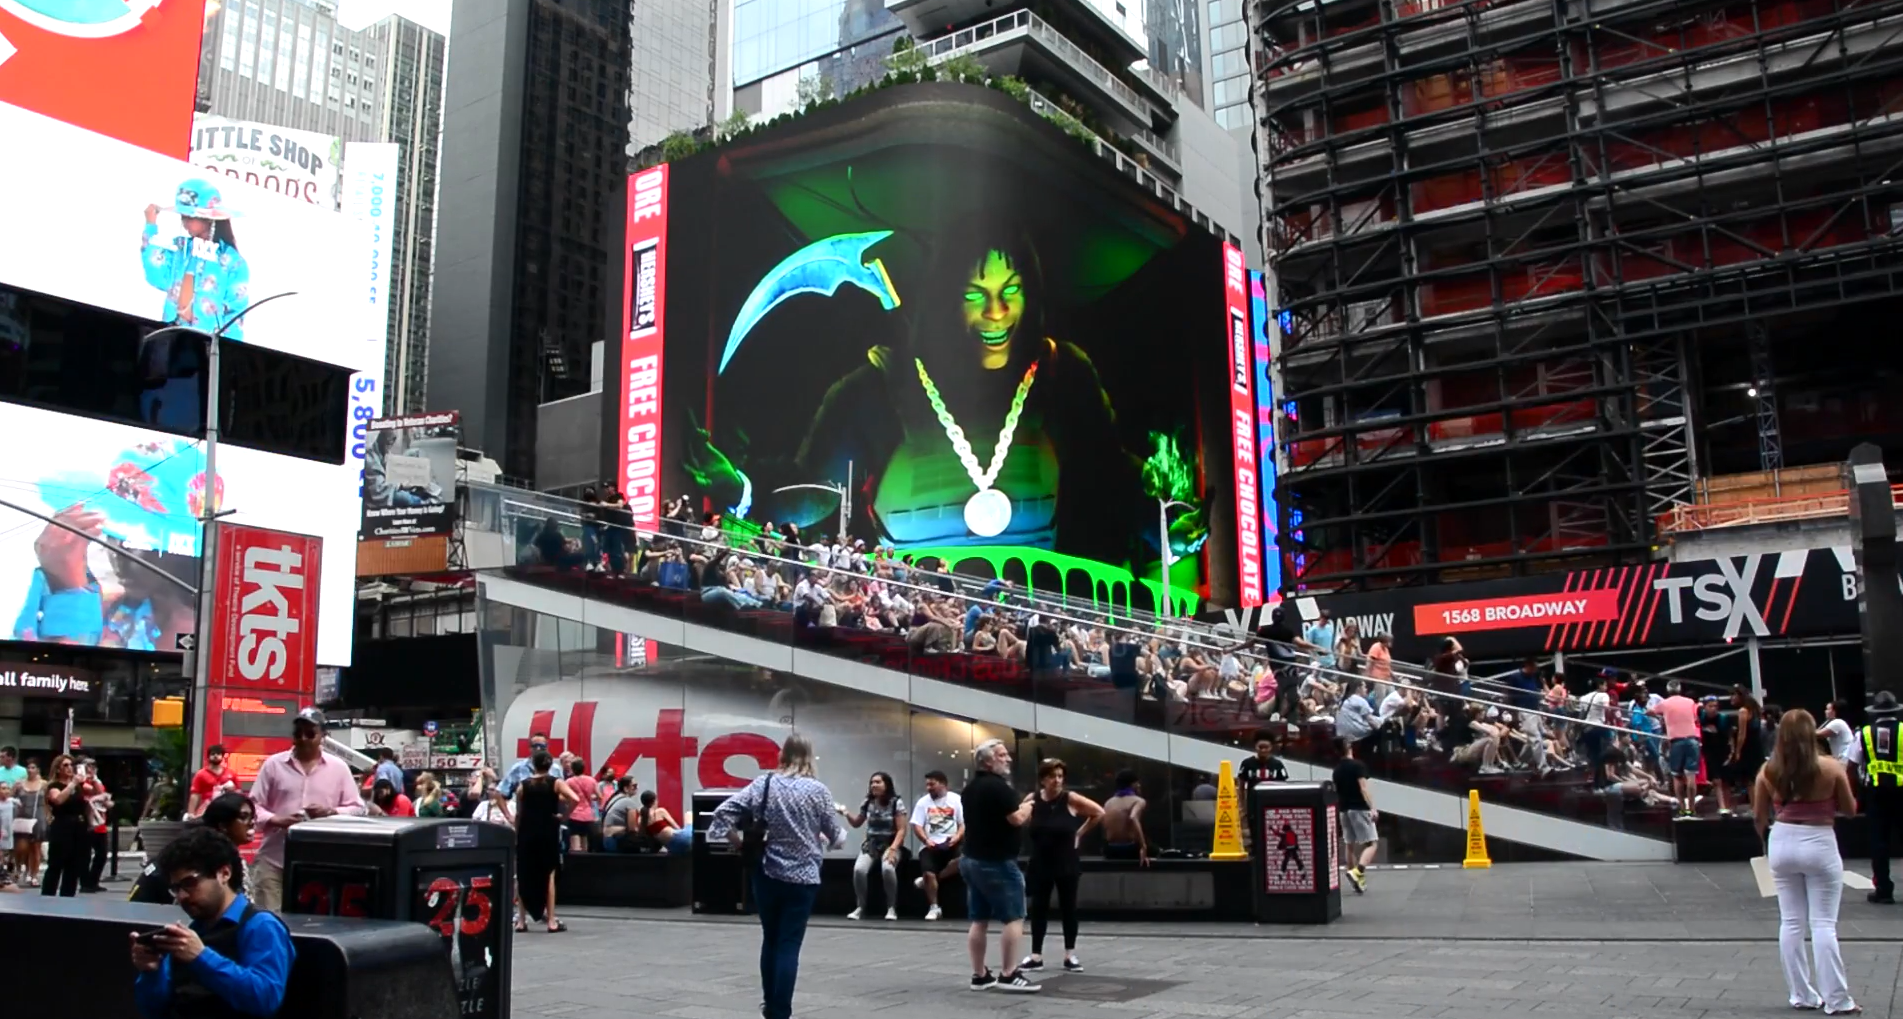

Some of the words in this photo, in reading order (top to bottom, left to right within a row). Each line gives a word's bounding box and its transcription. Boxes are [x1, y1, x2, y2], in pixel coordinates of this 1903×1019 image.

[191, 126, 262, 152] ITTLE
[269, 134, 323, 177] SHOP
[634, 165, 663, 224] ORE
[629, 354, 658, 419] FREE
[1236, 409, 1253, 465] FREE
[1238, 466, 1260, 602] CHOCOLATE
[237, 544, 304, 681] tkts
[1442, 609, 1481, 625] 1568
[1484, 599, 1588, 622] BROADWAY
[1653, 554, 1771, 639] TSX
[1302, 613, 1395, 643] BAWAY
[20, 672, 67, 692] family
[425, 876, 493, 937] 25
